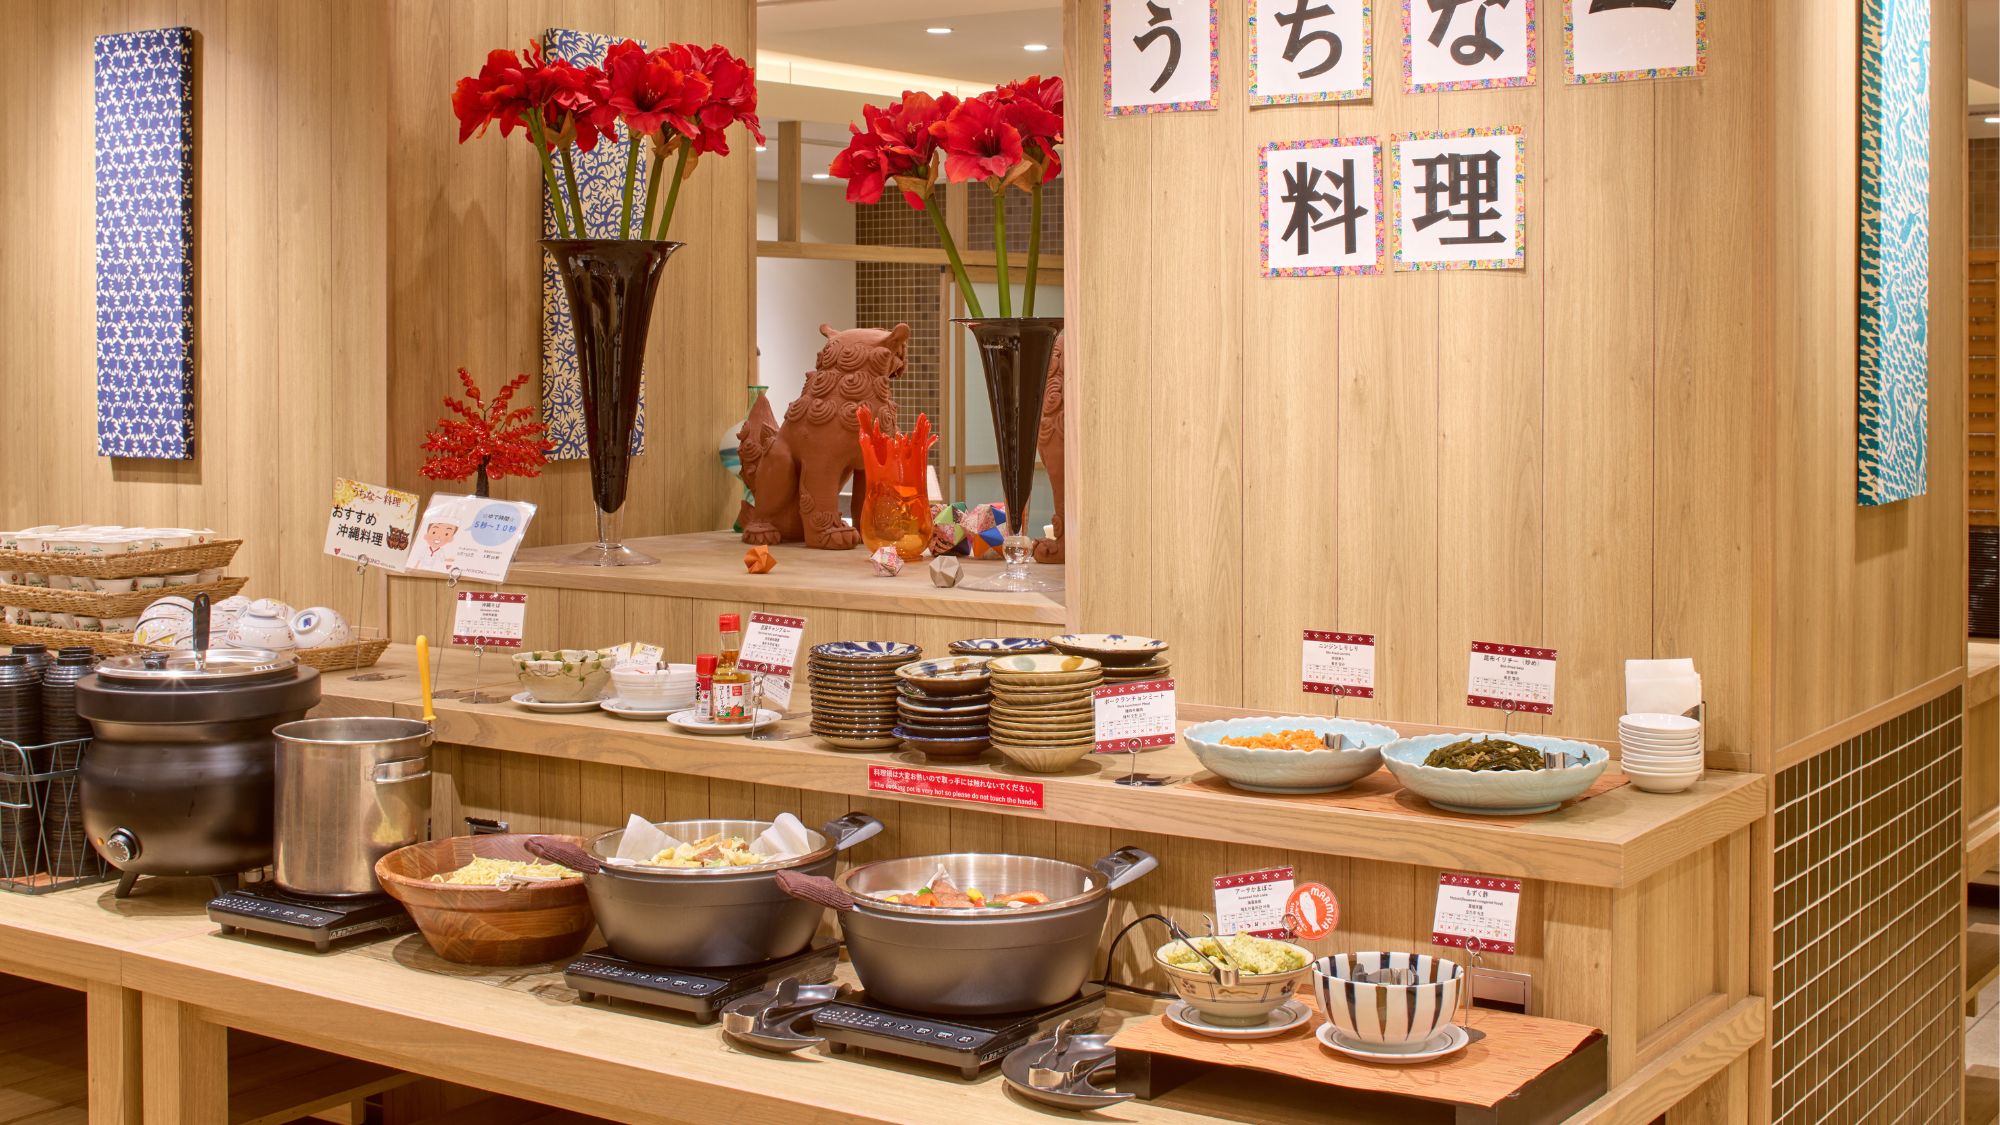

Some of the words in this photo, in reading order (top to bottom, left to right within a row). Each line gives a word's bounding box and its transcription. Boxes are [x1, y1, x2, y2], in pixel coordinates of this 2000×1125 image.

[332, 505, 377, 526] おすすめ
[336, 523, 384, 547] 沖縄料理
[1104, 693, 1165, 705] ポークランチョンミート
[921, 788, 934, 796] very
[952, 791, 971, 799] please
[971, 792, 979, 800] do
[980, 793, 989, 801] not
[990, 795, 1006, 803] touch
[1006, 796, 1017, 804] the
[1017, 798, 1039, 807] handle.
